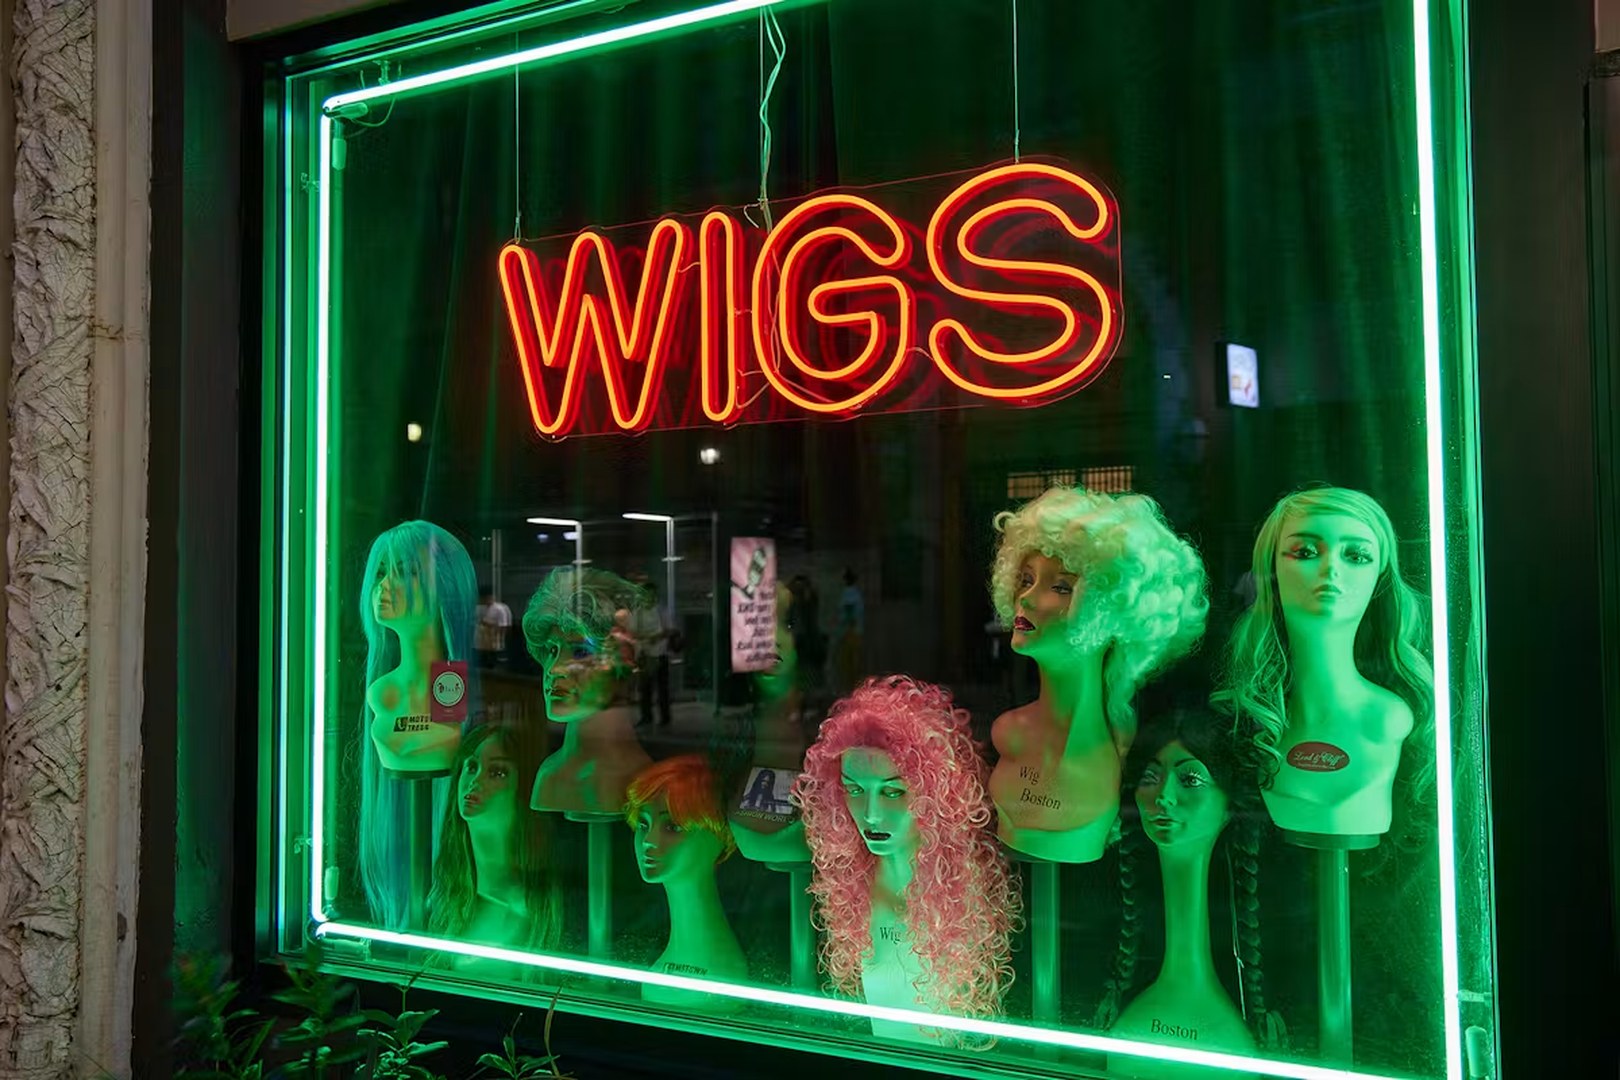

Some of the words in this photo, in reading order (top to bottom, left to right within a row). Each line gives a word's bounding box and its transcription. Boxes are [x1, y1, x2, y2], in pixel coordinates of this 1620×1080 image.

[498, 163, 1112, 434] WIGS
[1020, 766, 1040, 785] Wig
[1020, 788, 1061, 810] Boston
[880, 927, 901, 945] Wig
[1151, 1018, 1198, 1041] Boston
